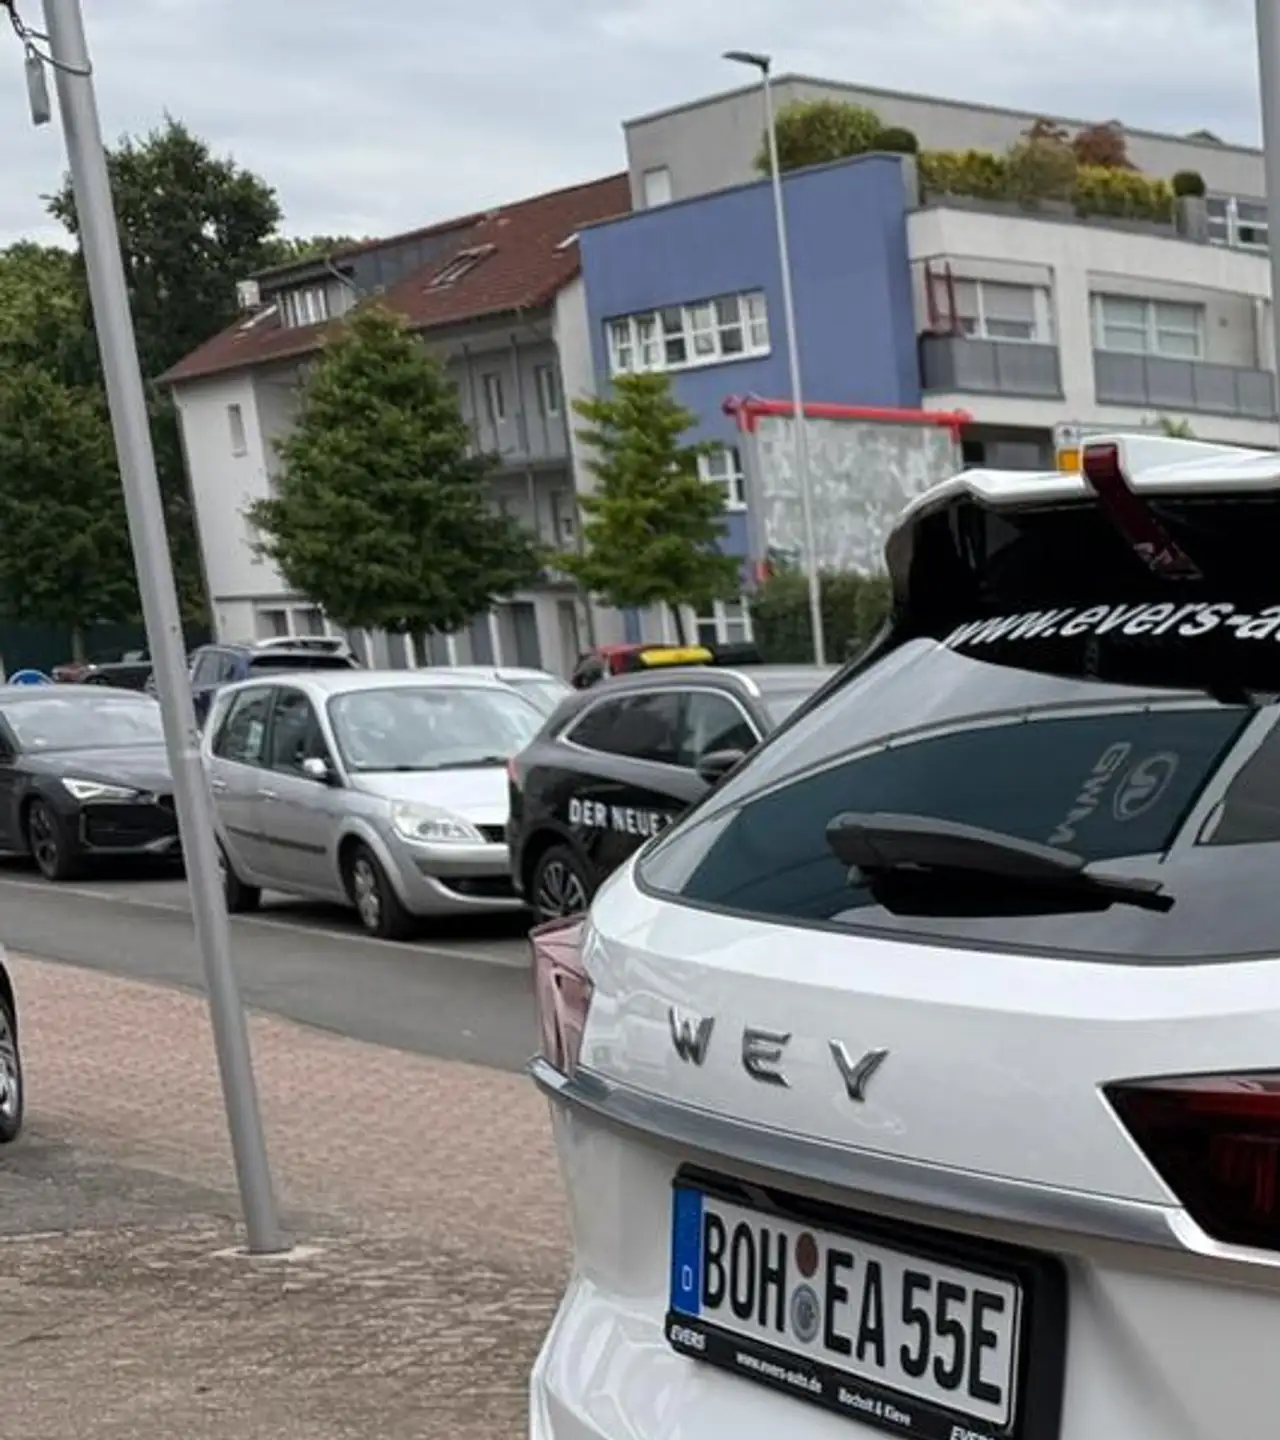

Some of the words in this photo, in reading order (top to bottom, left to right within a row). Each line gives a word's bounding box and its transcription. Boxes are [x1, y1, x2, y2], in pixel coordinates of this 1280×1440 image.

[568, 798, 607, 829] DER
[611, 806, 660, 838] NEUE
[669, 1004, 890, 1103] WEY
[670, 1324, 707, 1350] EVERS
[703, 1211, 788, 1333] BOH
[824, 1247, 886, 1368] EA
[899, 1269, 1006, 1406] 55E
